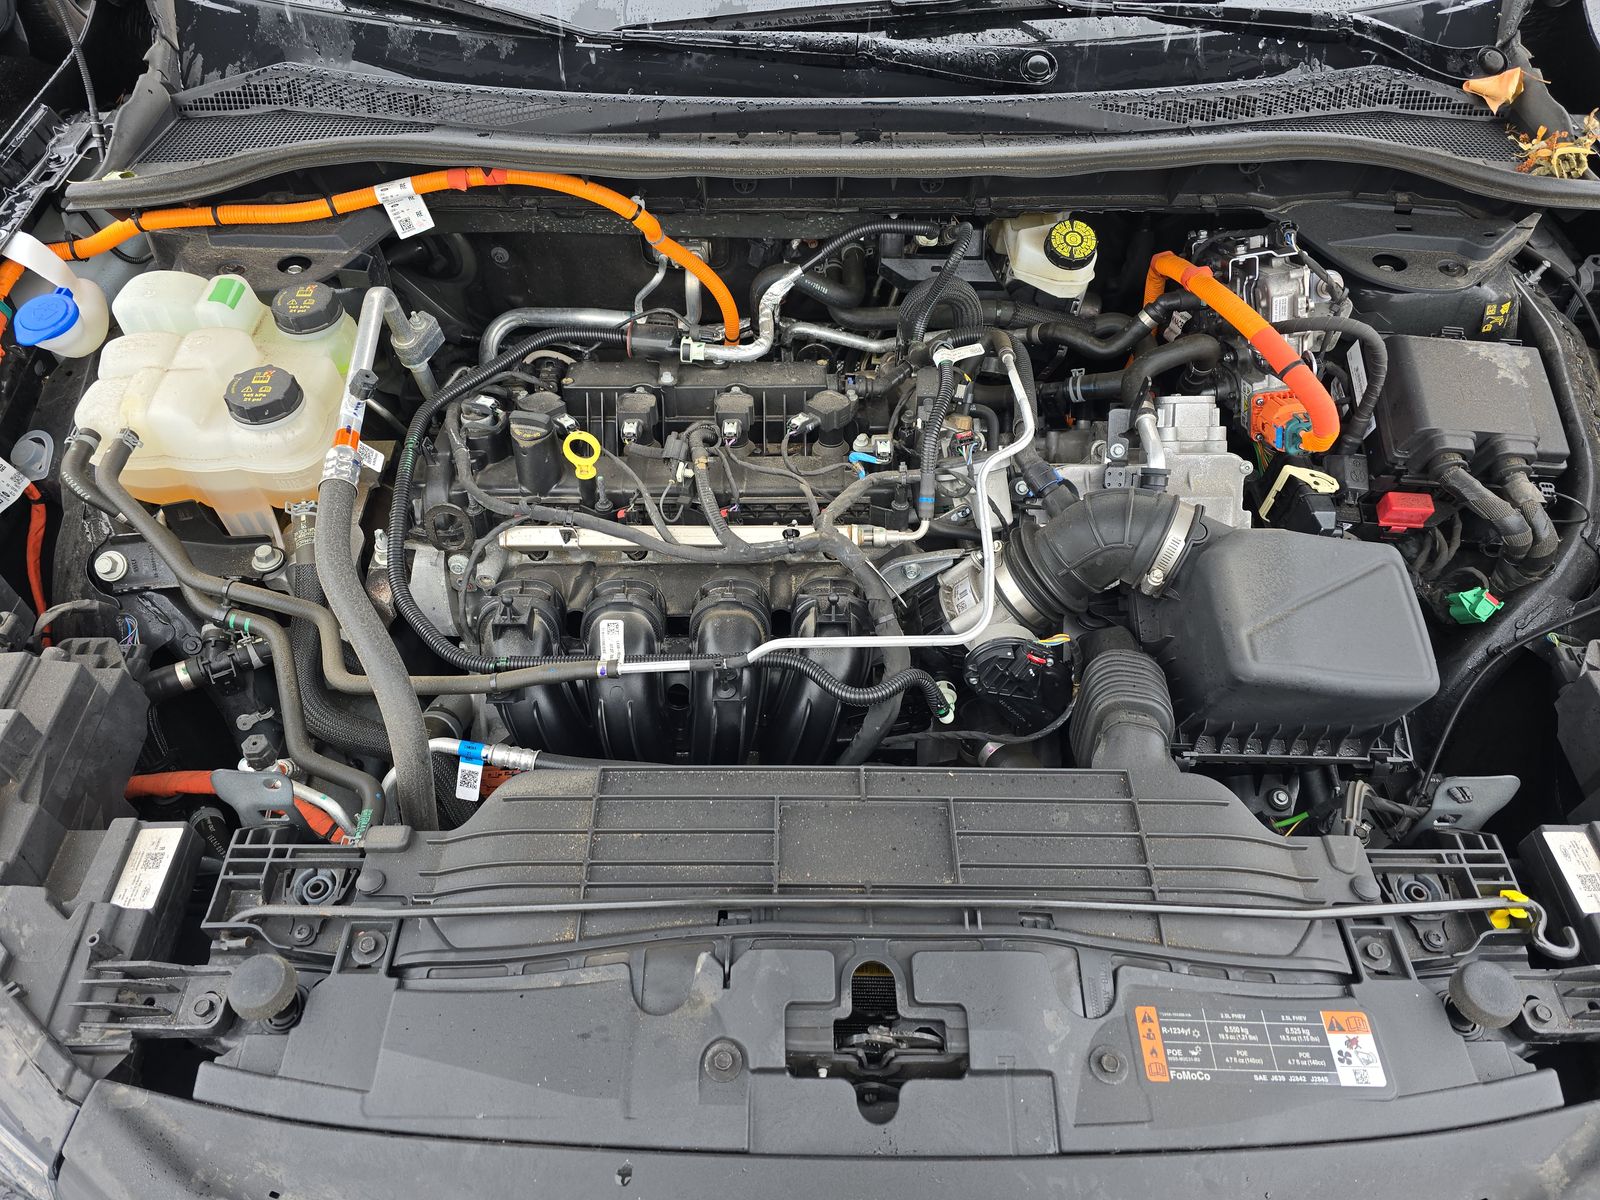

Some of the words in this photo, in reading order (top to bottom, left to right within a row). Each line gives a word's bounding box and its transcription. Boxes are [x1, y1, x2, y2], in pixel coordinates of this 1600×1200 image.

[1162, 1026, 1191, 1036] R-1234yf
[1240, 1026, 1249, 1035] kg
[1302, 1027, 1310, 1036] kg
[1166, 1048, 1183, 1056] POE
[1170, 1070, 1211, 1081] FoMoCo
